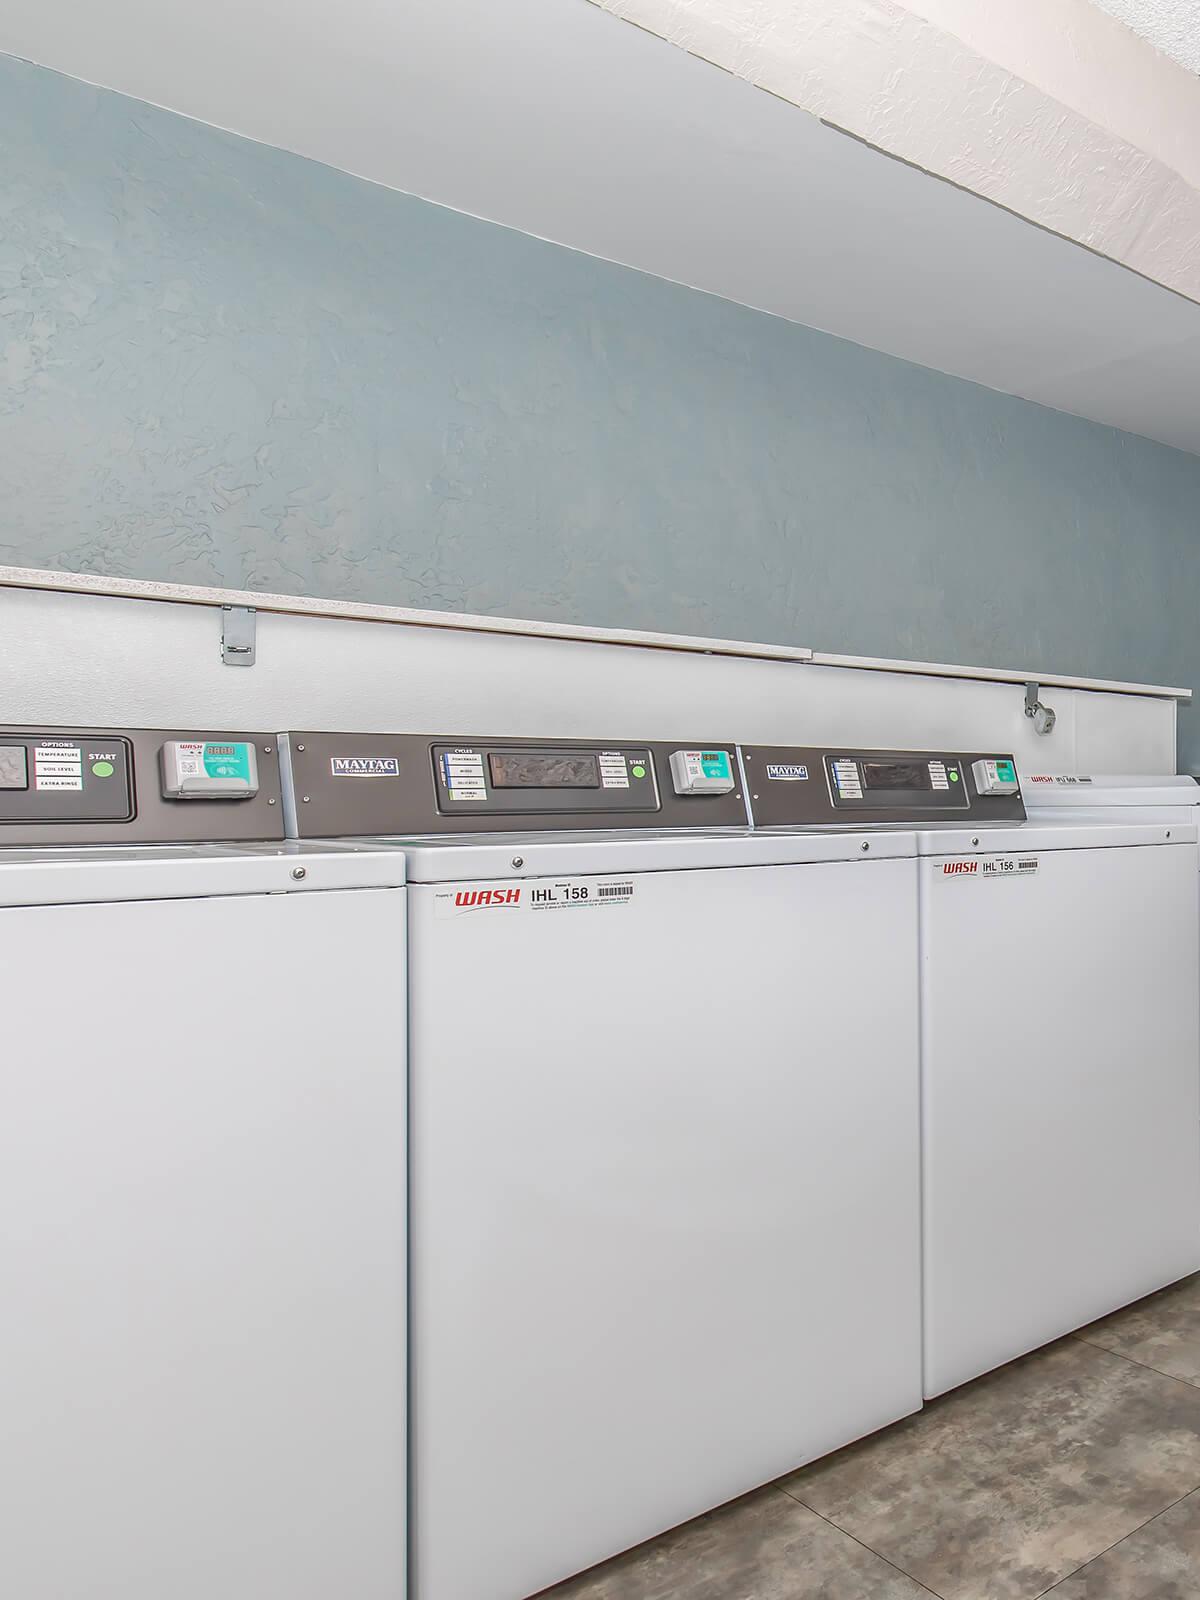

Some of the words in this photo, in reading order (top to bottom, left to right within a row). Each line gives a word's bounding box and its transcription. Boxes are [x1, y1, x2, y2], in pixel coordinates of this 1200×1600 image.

[88, 753, 117, 761] START
[335, 759, 395, 770] MAYTAG
[769, 766, 806, 775] MAYTAG
[943, 861, 978, 874] WASH
[983, 862, 997, 872] IHL
[999, 861, 1014, 871] 156
[455, 888, 521, 906] WASH
[531, 889, 557, 902] IHL
[563, 886, 589, 900] 158
